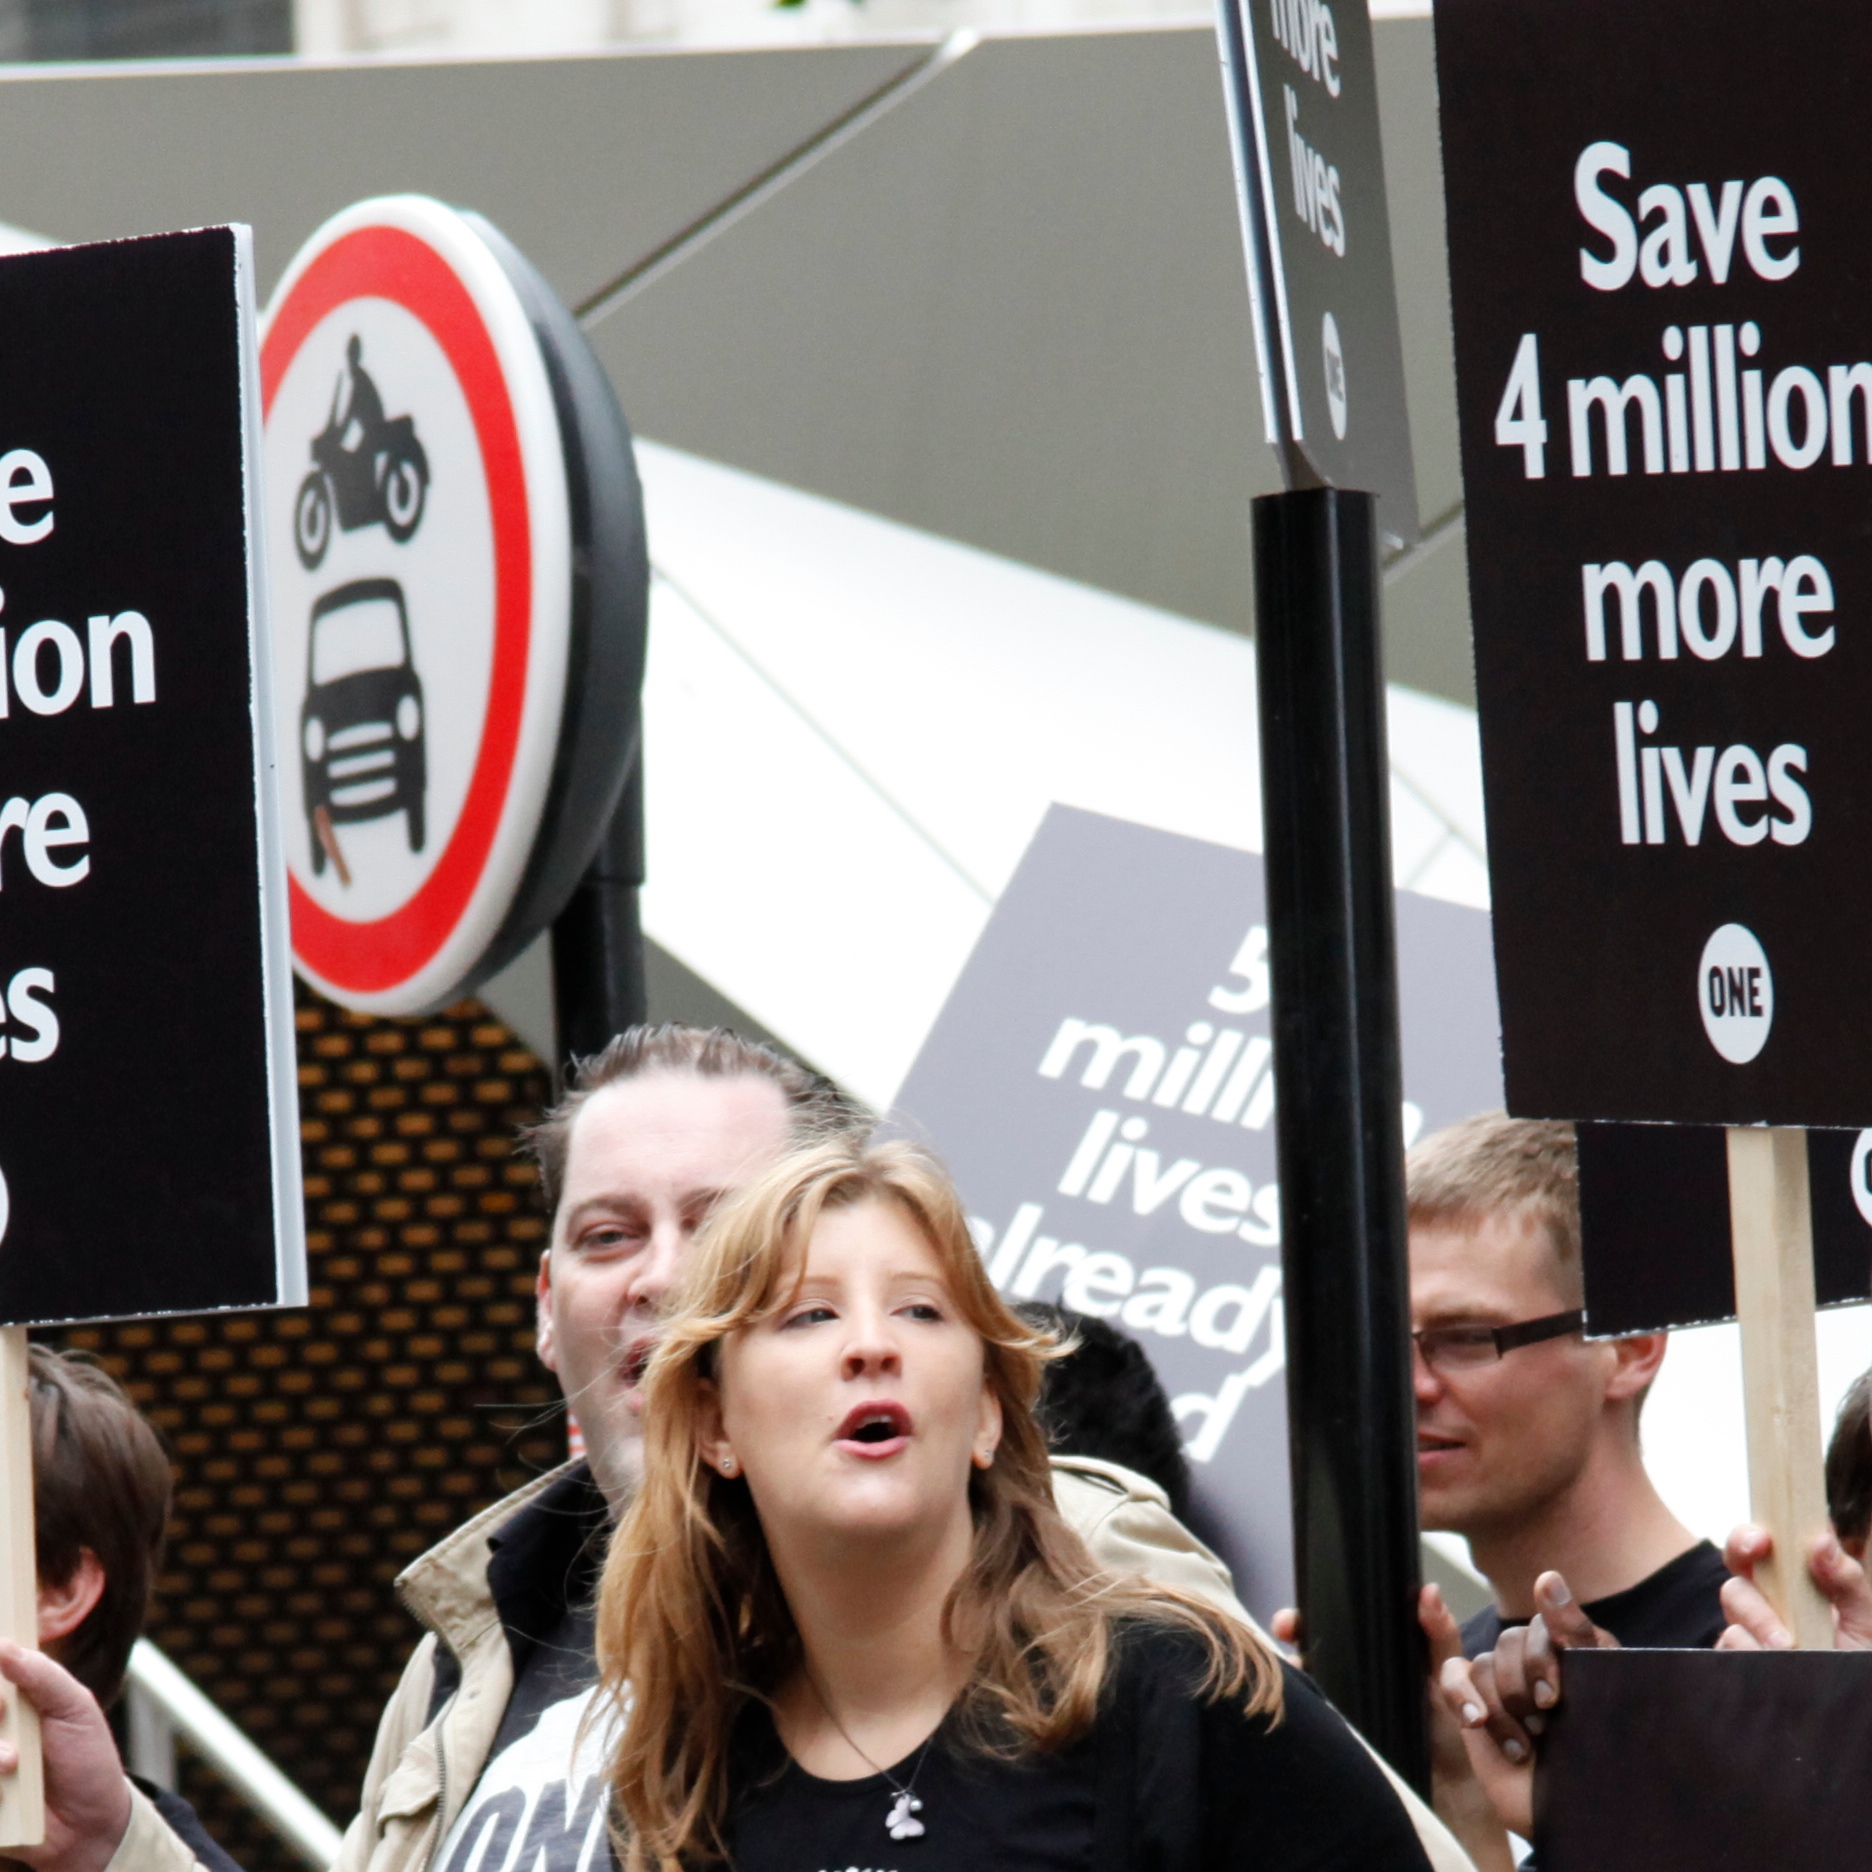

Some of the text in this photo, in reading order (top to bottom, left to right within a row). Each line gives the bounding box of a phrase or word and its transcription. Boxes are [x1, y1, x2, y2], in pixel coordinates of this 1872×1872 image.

[1284, 84, 1345, 257] lives
[1575, 142, 1799, 290] Save
[1496, 333, 1546, 478] 4
[1583, 556, 1834, 660] more
[1615, 700, 1811, 845] lives
[1709, 966, 1763, 1018] ONE
[1057, 1109, 1280, 1246] lives
